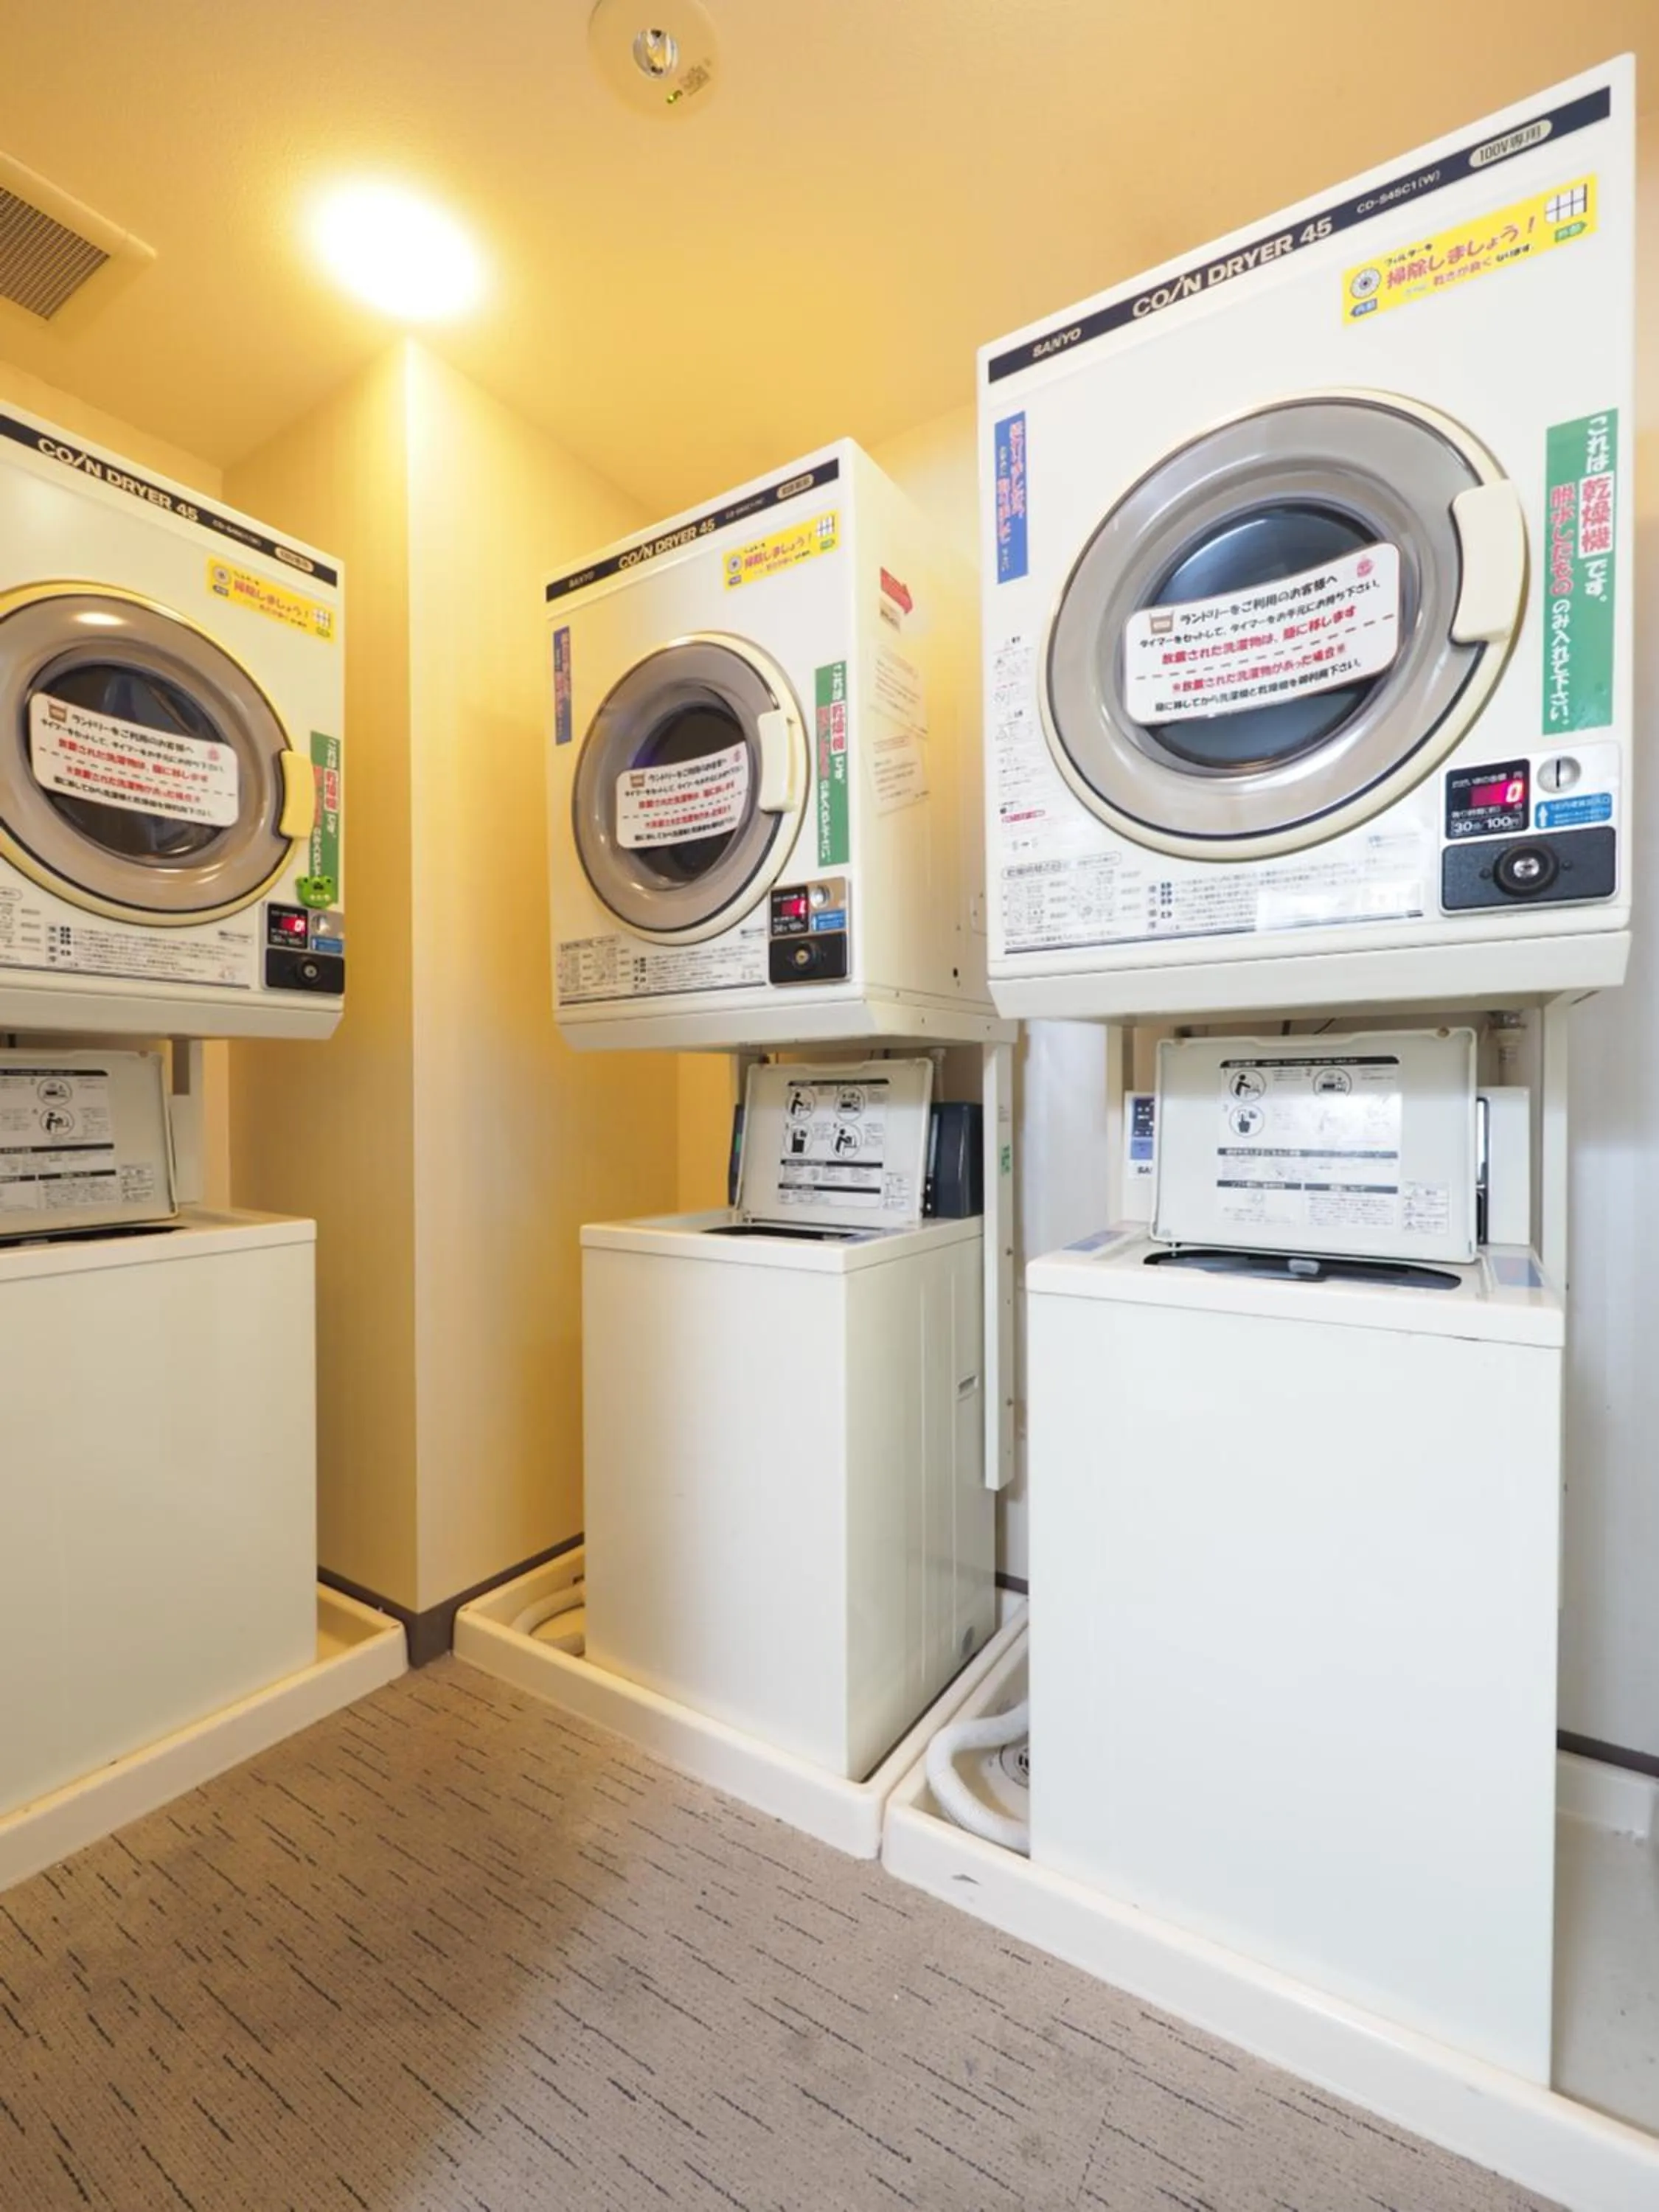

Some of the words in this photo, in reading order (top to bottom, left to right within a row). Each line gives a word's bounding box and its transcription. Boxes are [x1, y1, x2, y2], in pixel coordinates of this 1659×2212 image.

[1032, 327, 1082, 358] SANYO
[1207, 232, 1294, 286] DRYER
[1299, 216, 1333, 245] 45
[106, 468, 173, 510] DRYER
[176, 502, 200, 522] 45
[655, 526, 698, 554] DRYER
[699, 518, 716, 535] 45
[1506, 780, 1524, 804] 0
